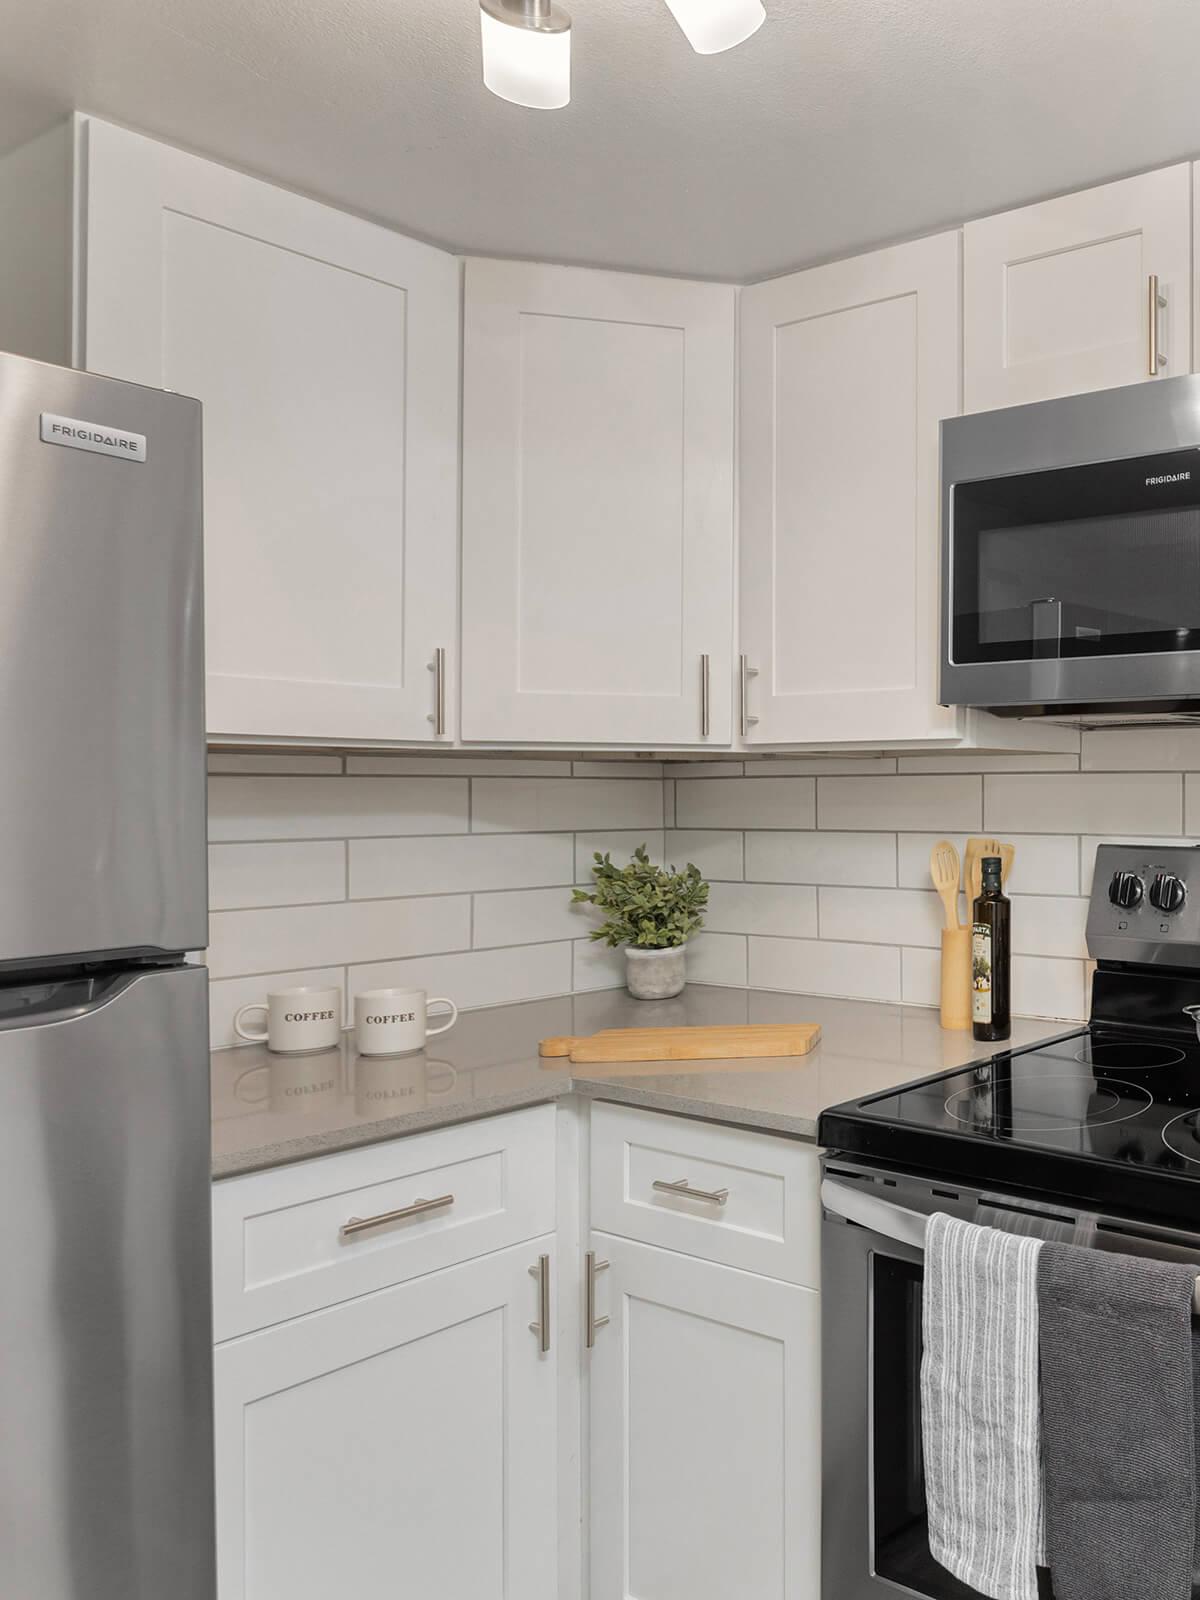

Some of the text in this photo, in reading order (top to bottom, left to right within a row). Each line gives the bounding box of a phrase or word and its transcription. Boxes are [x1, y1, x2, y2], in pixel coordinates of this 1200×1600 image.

[51, 423, 139, 452] FRIGIDAIRE
[1145, 471, 1191, 486] FRIGIDAIRE
[284, 1010, 335, 1022] COFFEE
[365, 1012, 416, 1025] COFFEE
